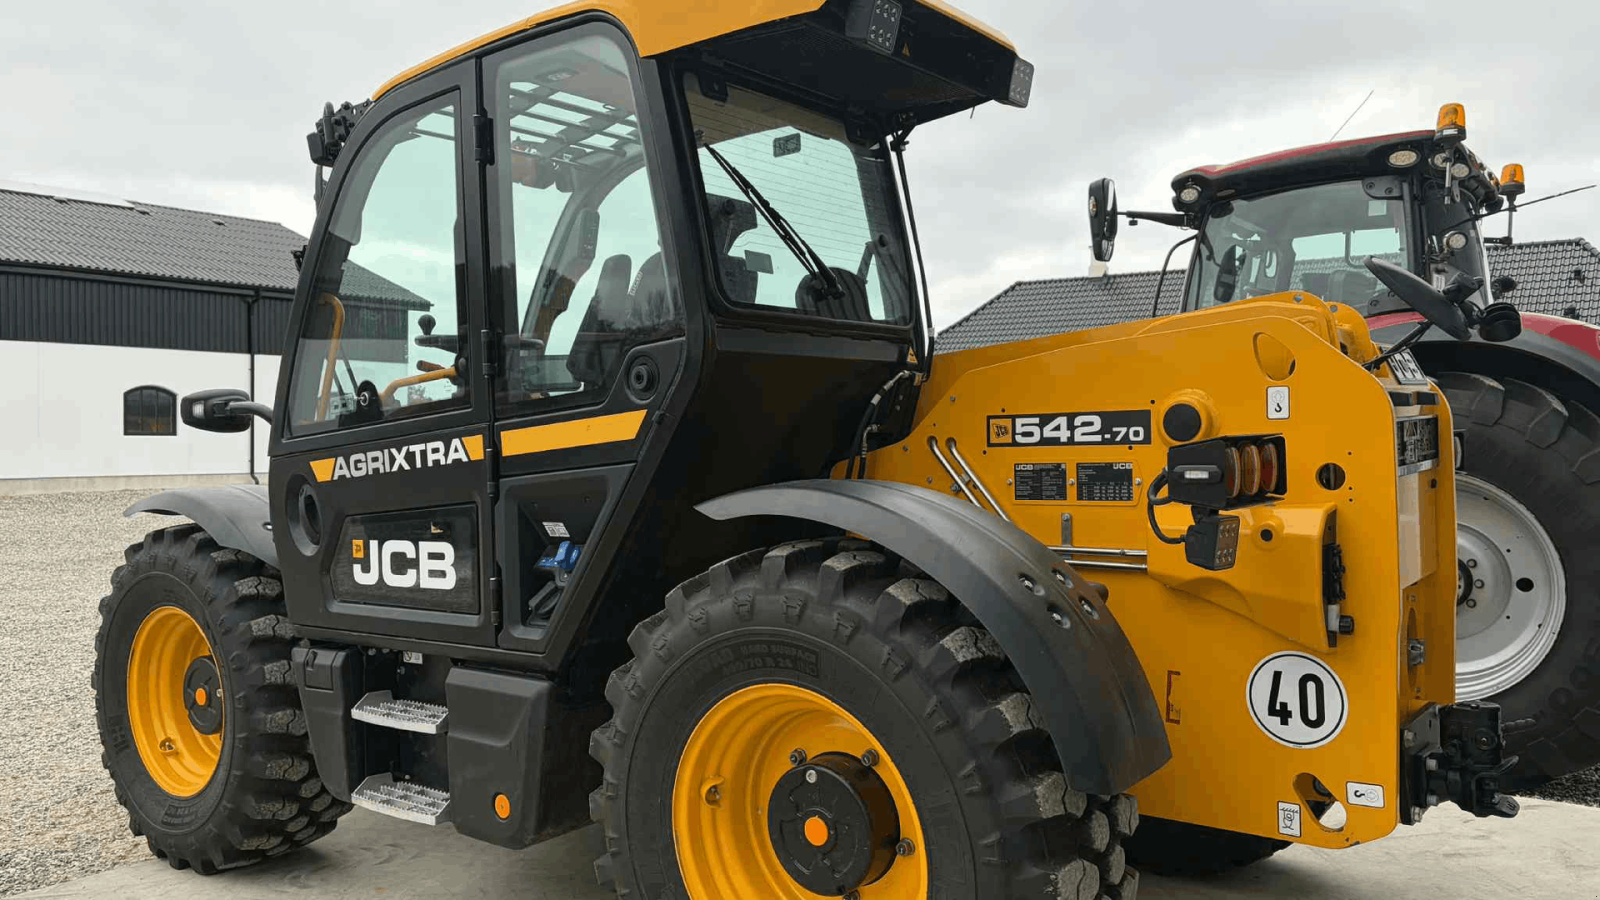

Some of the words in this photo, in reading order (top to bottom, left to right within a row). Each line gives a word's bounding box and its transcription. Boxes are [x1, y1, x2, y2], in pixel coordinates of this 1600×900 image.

[1014, 414, 1145, 444] 542-70
[332, 437, 469, 481] AGRIXTRA
[352, 539, 457, 590] JCB
[1267, 670, 1326, 729] 40
